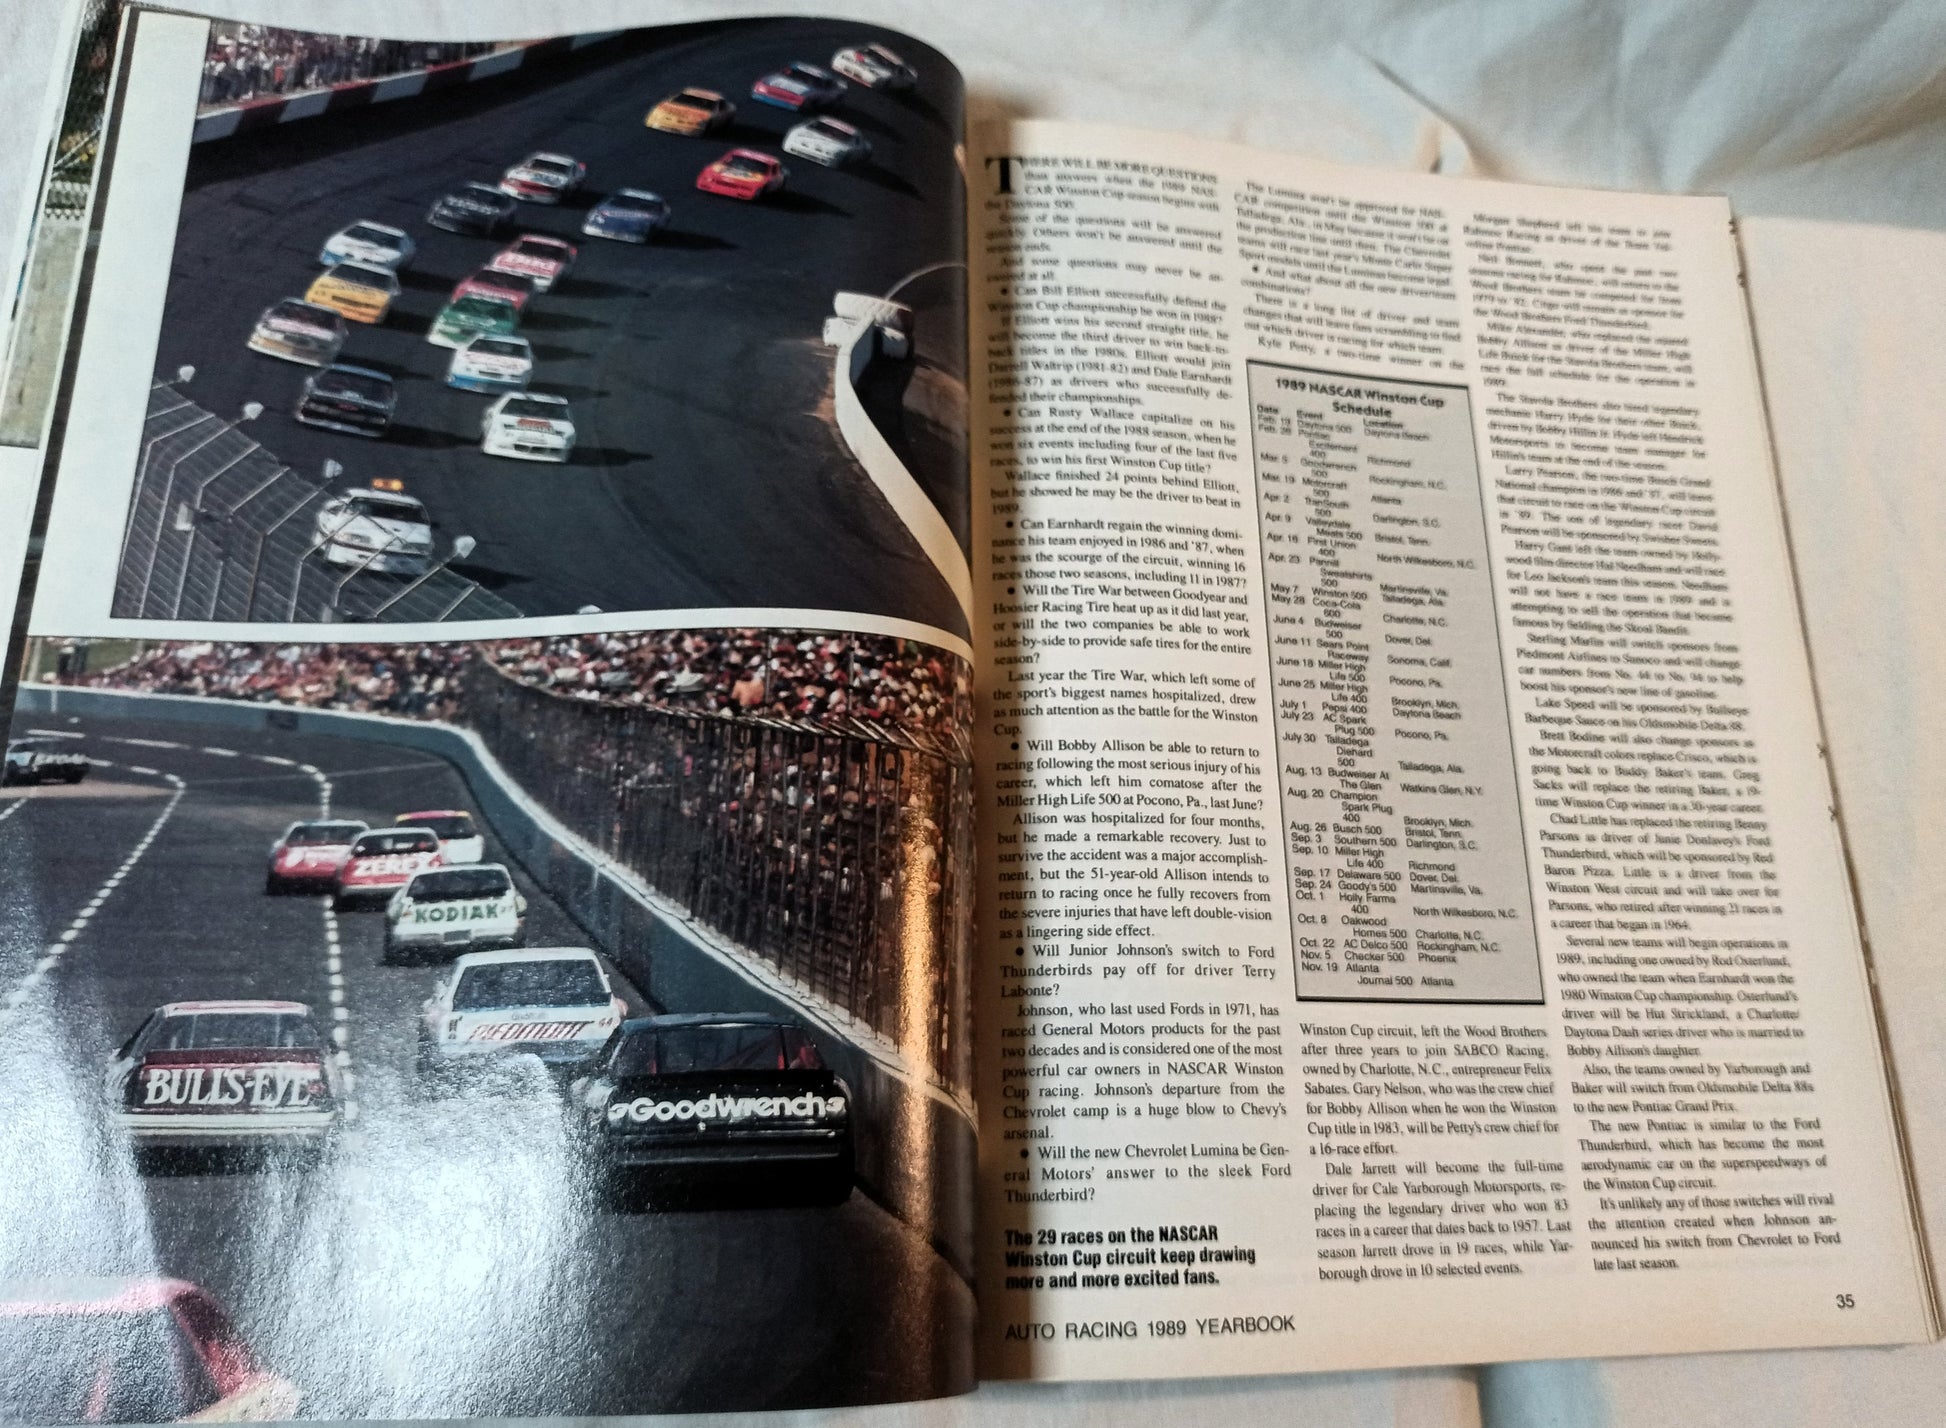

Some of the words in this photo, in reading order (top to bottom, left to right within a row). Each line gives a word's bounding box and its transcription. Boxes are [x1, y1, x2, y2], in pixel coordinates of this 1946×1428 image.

[1333, 401, 1392, 418] Schedule
[1005, 471, 1049, 481] Wallace
[1055, 471, 1101, 481] finished
[1105, 472, 1118, 481] 24
[1124, 475, 1157, 486] points
[1162, 476, 1198, 488] behind
[1203, 480, 1240, 493] Elliott,
[1027, 740, 1053, 751] Will
[1058, 739, 1097, 753] Bobby
[1102, 740, 1145, 752] Allison
[1149, 741, 1164, 752] be
[1168, 741, 1193, 754] able
[1195, 744, 1207, 754] to
[1211, 746, 1244, 757] return
[1249, 748, 1261, 758] to
[997, 795, 1034, 808] Miller
[1038, 794, 1068, 809] High
[1071, 793, 1097, 805] Life
[1098, 793, 1121, 805] 500
[1123, 795, 1134, 805] at
[1137, 795, 1184, 808] Pocono,
[1186, 796, 1208, 809] Pa.,
[1210, 796, 1230, 809] last
[1232, 799, 1263, 811] June?
[1013, 813, 1058, 825] Allison
[1063, 814, 1086, 823] was
[1092, 812, 1165, 826] hospitalized
[1170, 813, 1186, 825] for
[1192, 813, 1215, 825] four
[1220, 817, 1265, 829] months,
[414, 904, 499, 923] KODIAK
[1033, 944, 1060, 957] Will
[1069, 944, 1107, 956] Junior
[1117, 943, 1173, 956] Johnson's
[1182, 945, 1220, 957] switch
[1228, 947, 1240, 957] to
[1248, 945, 1274, 957] Ford
[1000, 964, 1092, 977] Thunderbirds
[1103, 966, 1126, 979] pay
[1137, 962, 1157, 975] off
[1167, 963, 1185, 976] for
[1195, 963, 1234, 976] driver
[1242, 964, 1276, 980] Terry
[1302, 962, 1324, 971] Nov.
[1327, 963, 1338, 972] 19
[1346, 964, 1380, 973] Atlanta
[1300, 1024, 1347, 1036] Winston
[1350, 1024, 1374, 1039] Cup
[1377, 1026, 1417, 1038] circuit,
[1421, 1025, 1441, 1037] left
[1443, 1026, 1460, 1037] the
[1464, 1026, 1497, 1037] Wood
[1501, 1026, 1547, 1038] Brothers
[628, 1092, 826, 1122] Goodwrench
[1326, 1163, 1352, 1175] Dale
[1361, 1163, 1396, 1175] Jarrett
[1404, 1162, 1427, 1174] will
[1436, 1162, 1479, 1173] become
[1488, 1161, 1505, 1173] the
[1514, 1160, 1563, 1173] full-time
[1006, 1230, 1033, 1246] The
[1038, 1229, 1056, 1245] 29
[1061, 1231, 1103, 1244] races
[1108, 1231, 1126, 1244] on
[1131, 1227, 1154, 1243] the
[1159, 1225, 1218, 1242] NASCAR
[1591, 1238, 1639, 1250] nounced
[1643, 1237, 1661, 1249] his
[1665, 1237, 1703, 1248] switch
[1706, 1235, 1734, 1248] from
[1737, 1234, 1792, 1247] Chevrolet
[1797, 1235, 1810, 1245] to
[1814, 1232, 1841, 1244] Ford
[1006, 1251, 1068, 1268] Winston
[1073, 1250, 1101, 1268] Cup
[1106, 1248, 1156, 1265] circuit
[1160, 1249, 1195, 1266] keep
[1200, 1247, 1256, 1264] drawing
[1594, 1259, 1615, 1271] late
[1616, 1258, 1637, 1270] last
[1639, 1260, 1679, 1270] season.
[1006, 1276, 1044, 1290] more
[1049, 1272, 1077, 1289] and
[1082, 1274, 1119, 1287] more
[1124, 1269, 1179, 1287] excited
[1184, 1269, 1219, 1285] fans.
[1319, 1267, 1368, 1282] borough
[1371, 1265, 1404, 1279] drove
[1406, 1266, 1417, 1277] in
[1421, 1263, 1433, 1276] 10
[1437, 1263, 1481, 1276] selected
[1484, 1263, 1522, 1275] events.
[1837, 1295, 1855, 1308] 35
[1005, 1323, 1055, 1340] AUTO
[1066, 1321, 1138, 1339] RACING
[1149, 1320, 1186, 1337] 1989
[1196, 1316, 1295, 1334] YEARBOOK
